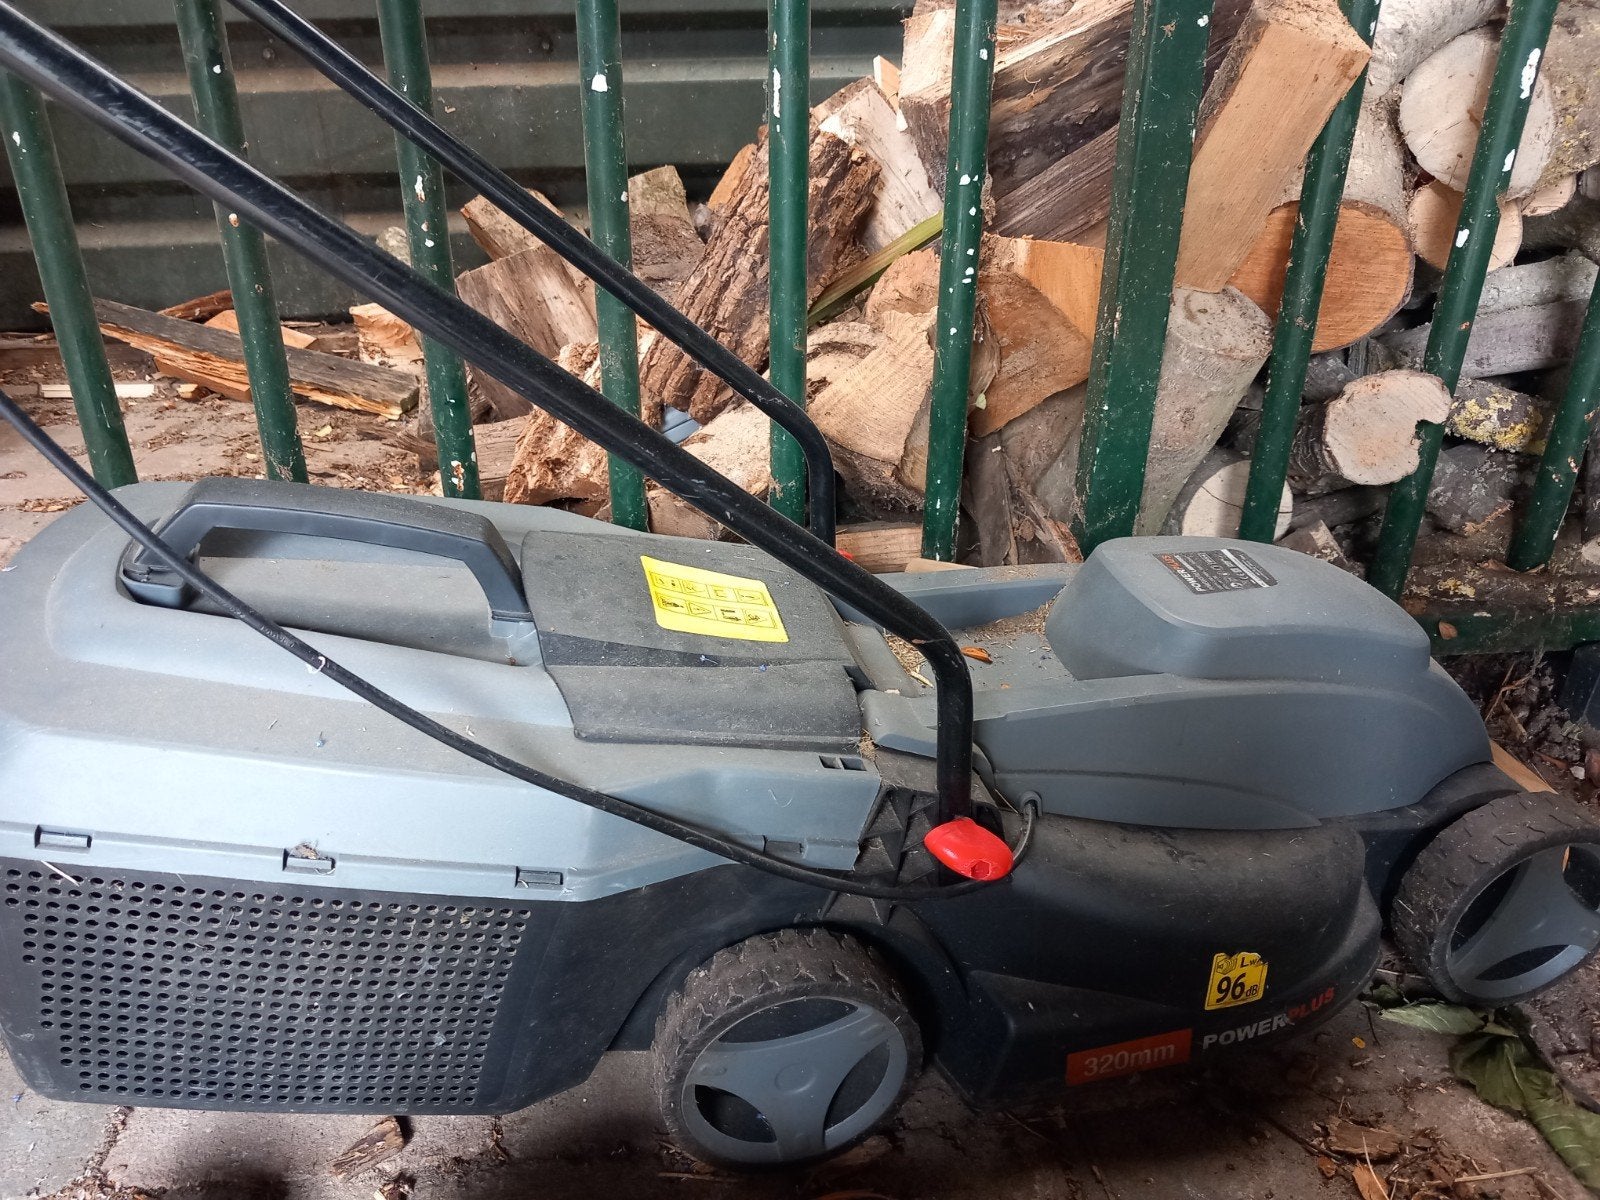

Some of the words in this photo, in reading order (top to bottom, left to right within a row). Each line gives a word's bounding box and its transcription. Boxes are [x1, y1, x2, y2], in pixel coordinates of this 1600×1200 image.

[1216, 972, 1247, 1003] 96
[1202, 988, 1335, 1049] POWERPLUS
[1084, 1044, 1175, 1077] 320mm
